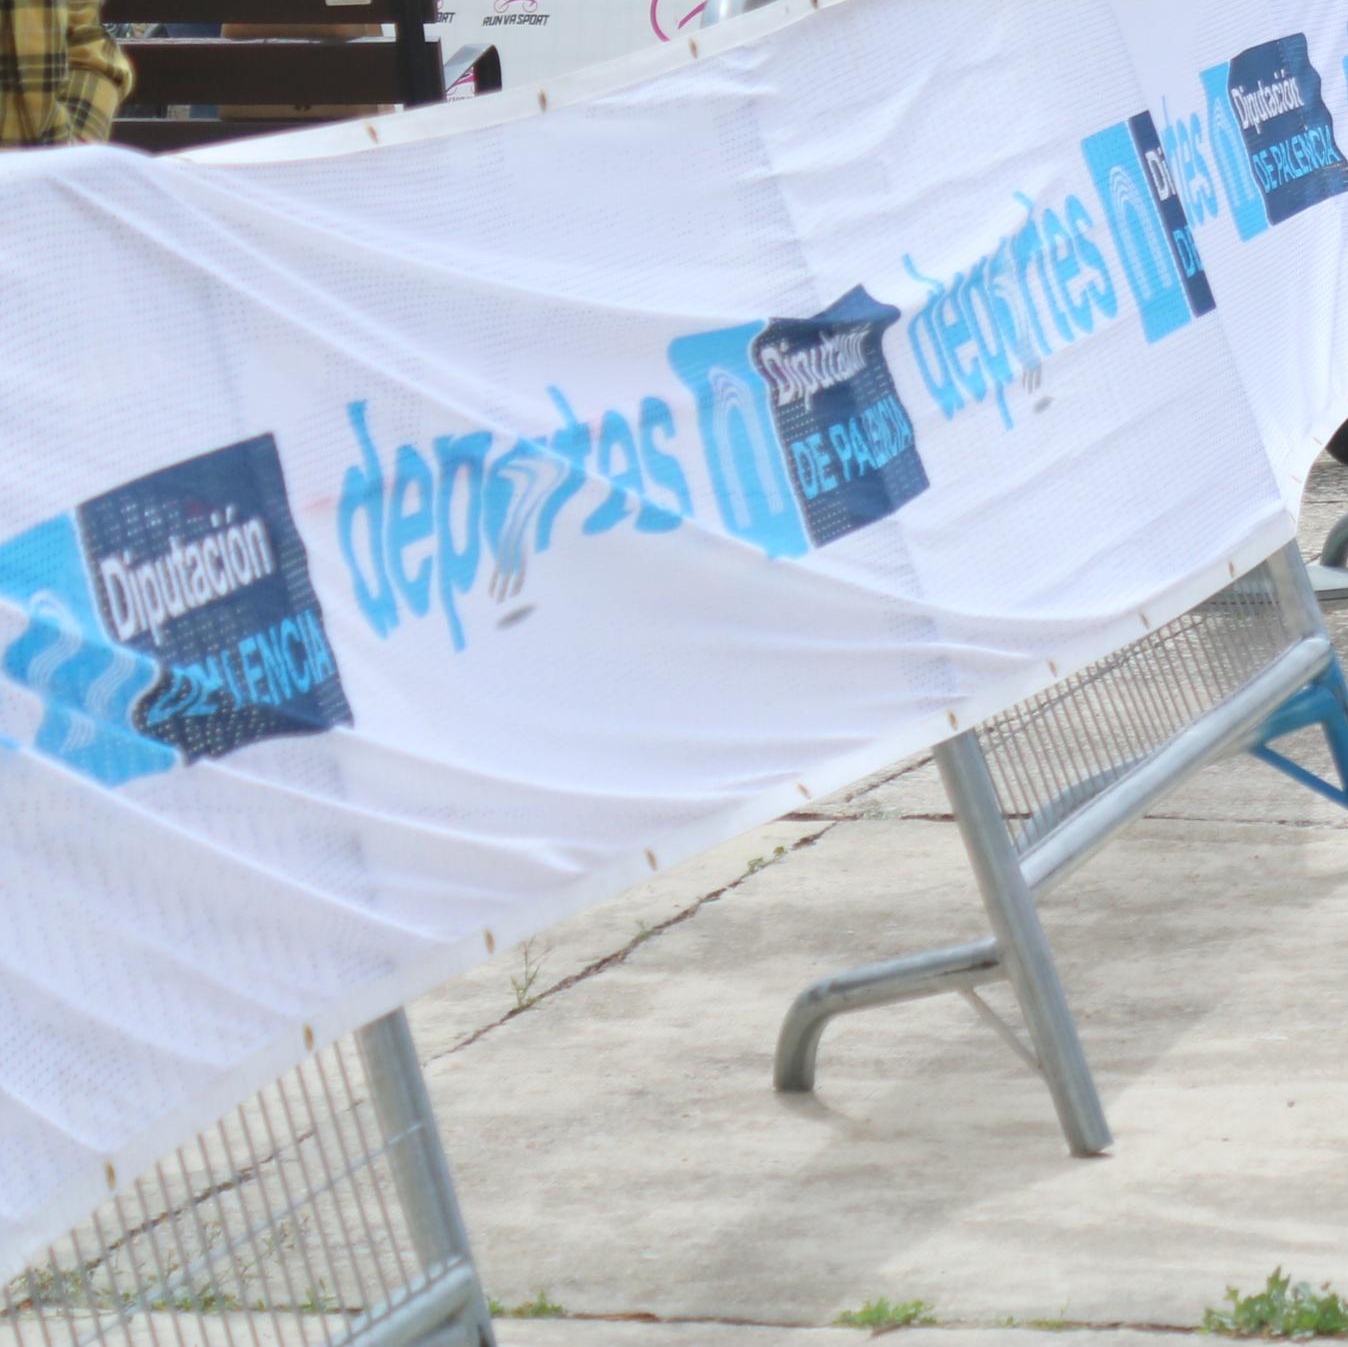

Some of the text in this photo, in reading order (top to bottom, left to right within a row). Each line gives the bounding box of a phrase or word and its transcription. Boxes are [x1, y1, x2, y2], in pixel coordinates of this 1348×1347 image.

[516, 13, 550, 26] SPORT
[1231, 69, 1304, 134] Diputación
[790, 432, 839, 502] DE
[101, 503, 273, 647] Diputación
